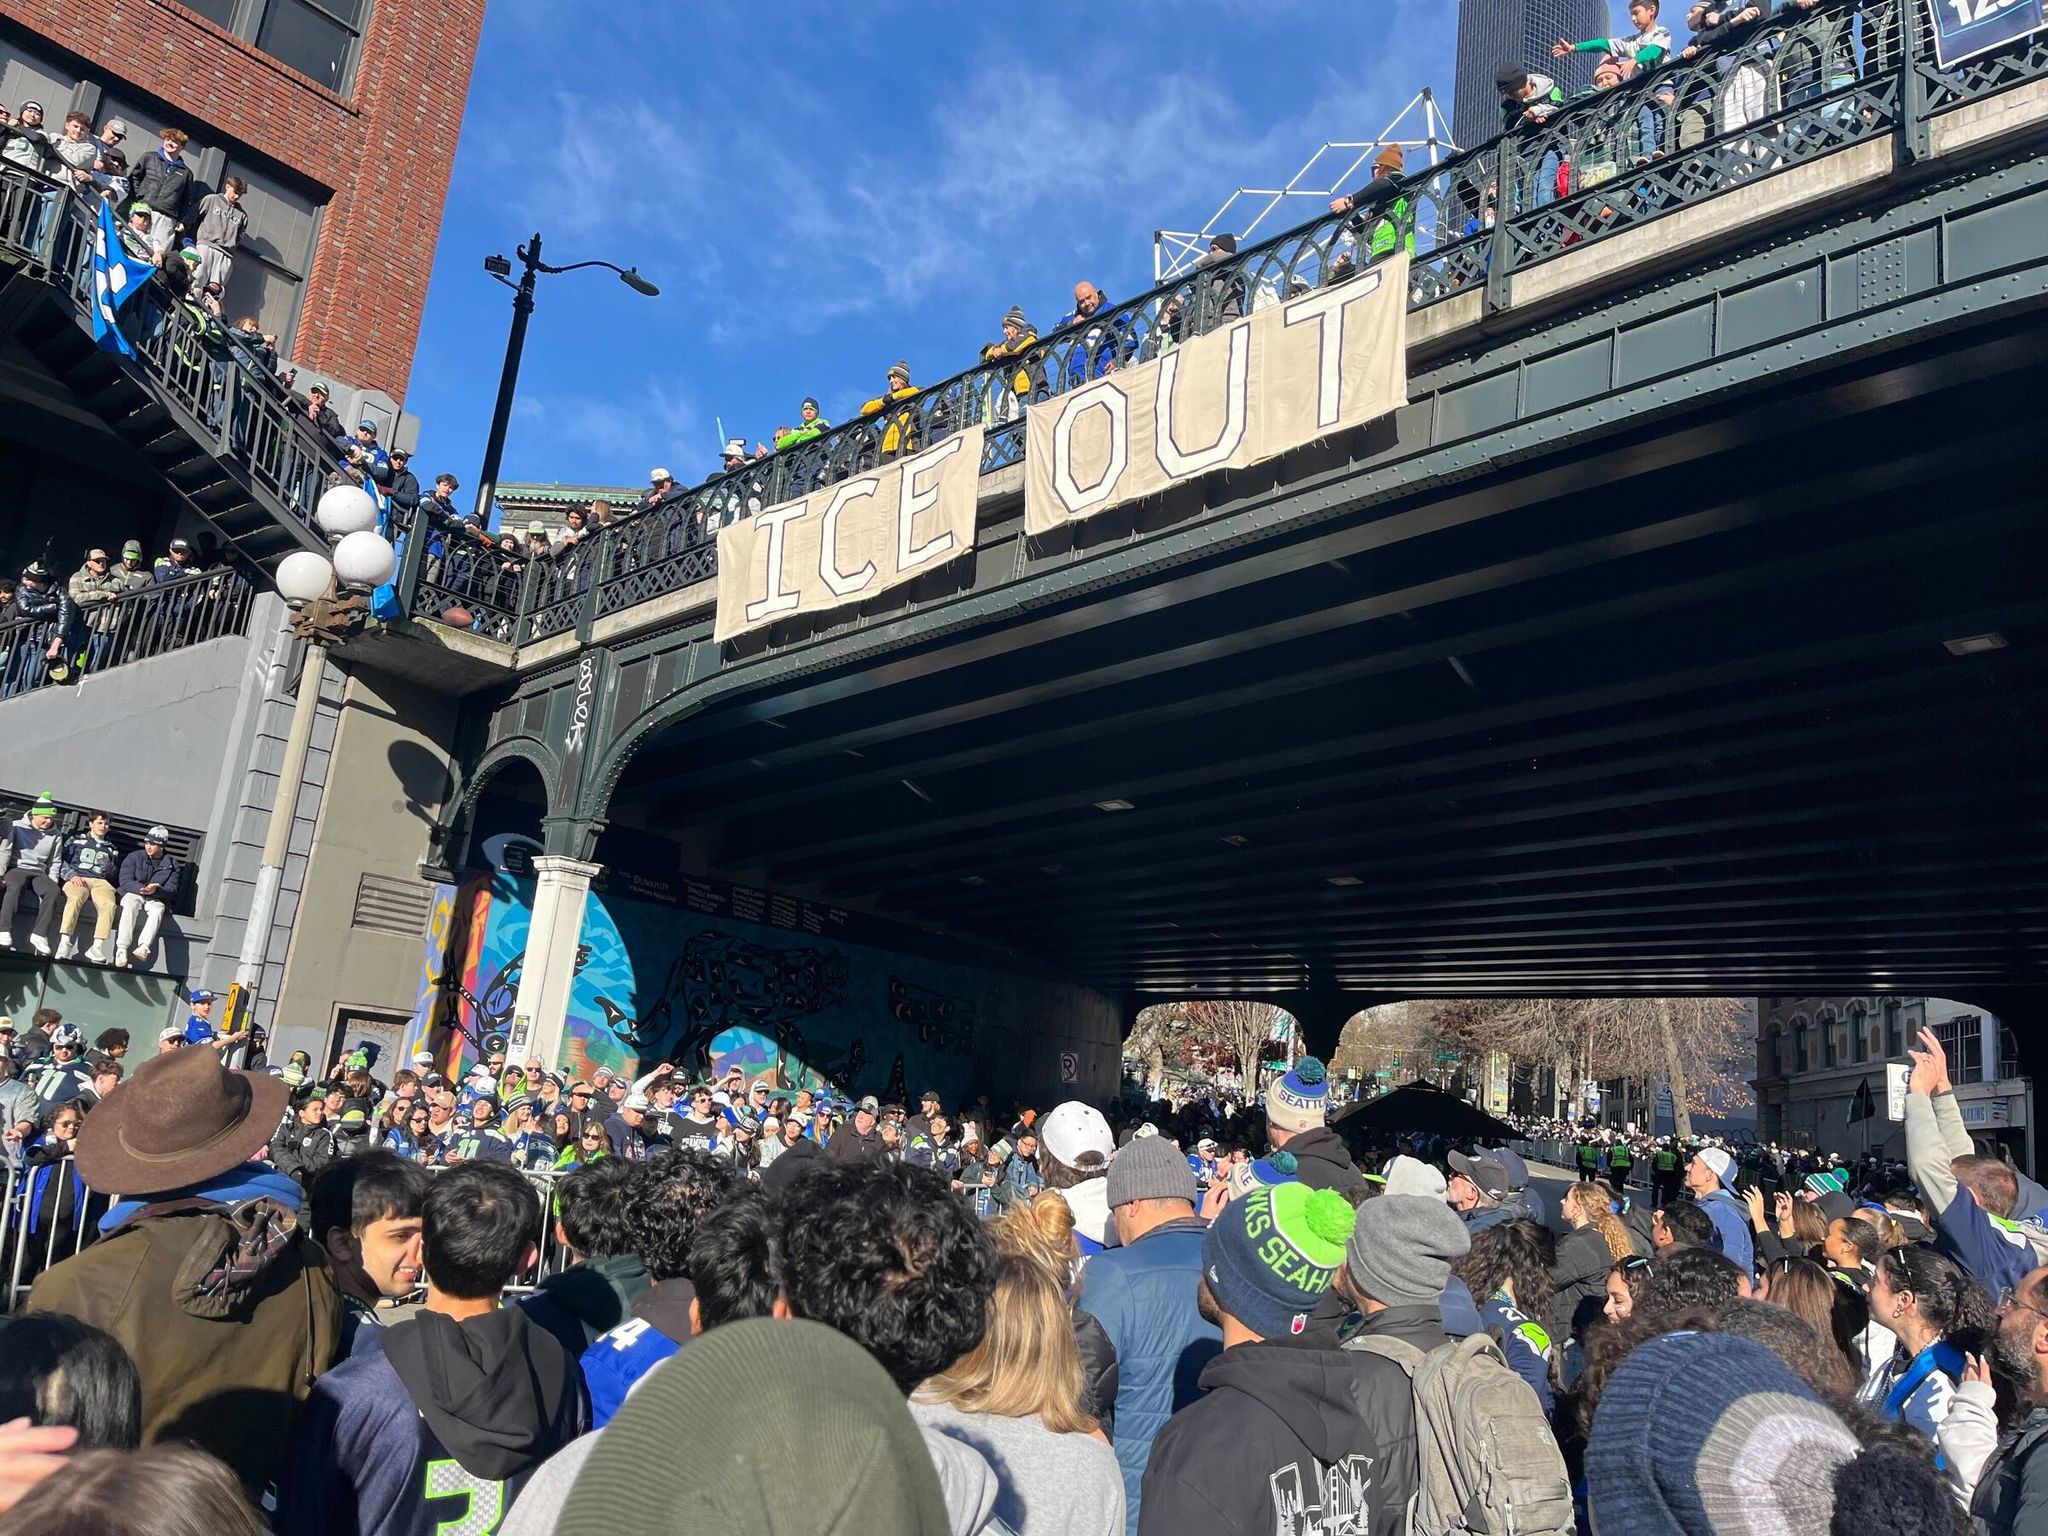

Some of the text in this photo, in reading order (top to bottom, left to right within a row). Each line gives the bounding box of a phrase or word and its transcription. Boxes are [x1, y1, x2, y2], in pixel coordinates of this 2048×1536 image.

[745, 270, 1383, 622] ICE OUT
[34, 1069, 67, 1101] 11
[1279, 1089, 1325, 1110] SEATTL
[456, 1138, 481, 1159] 11
